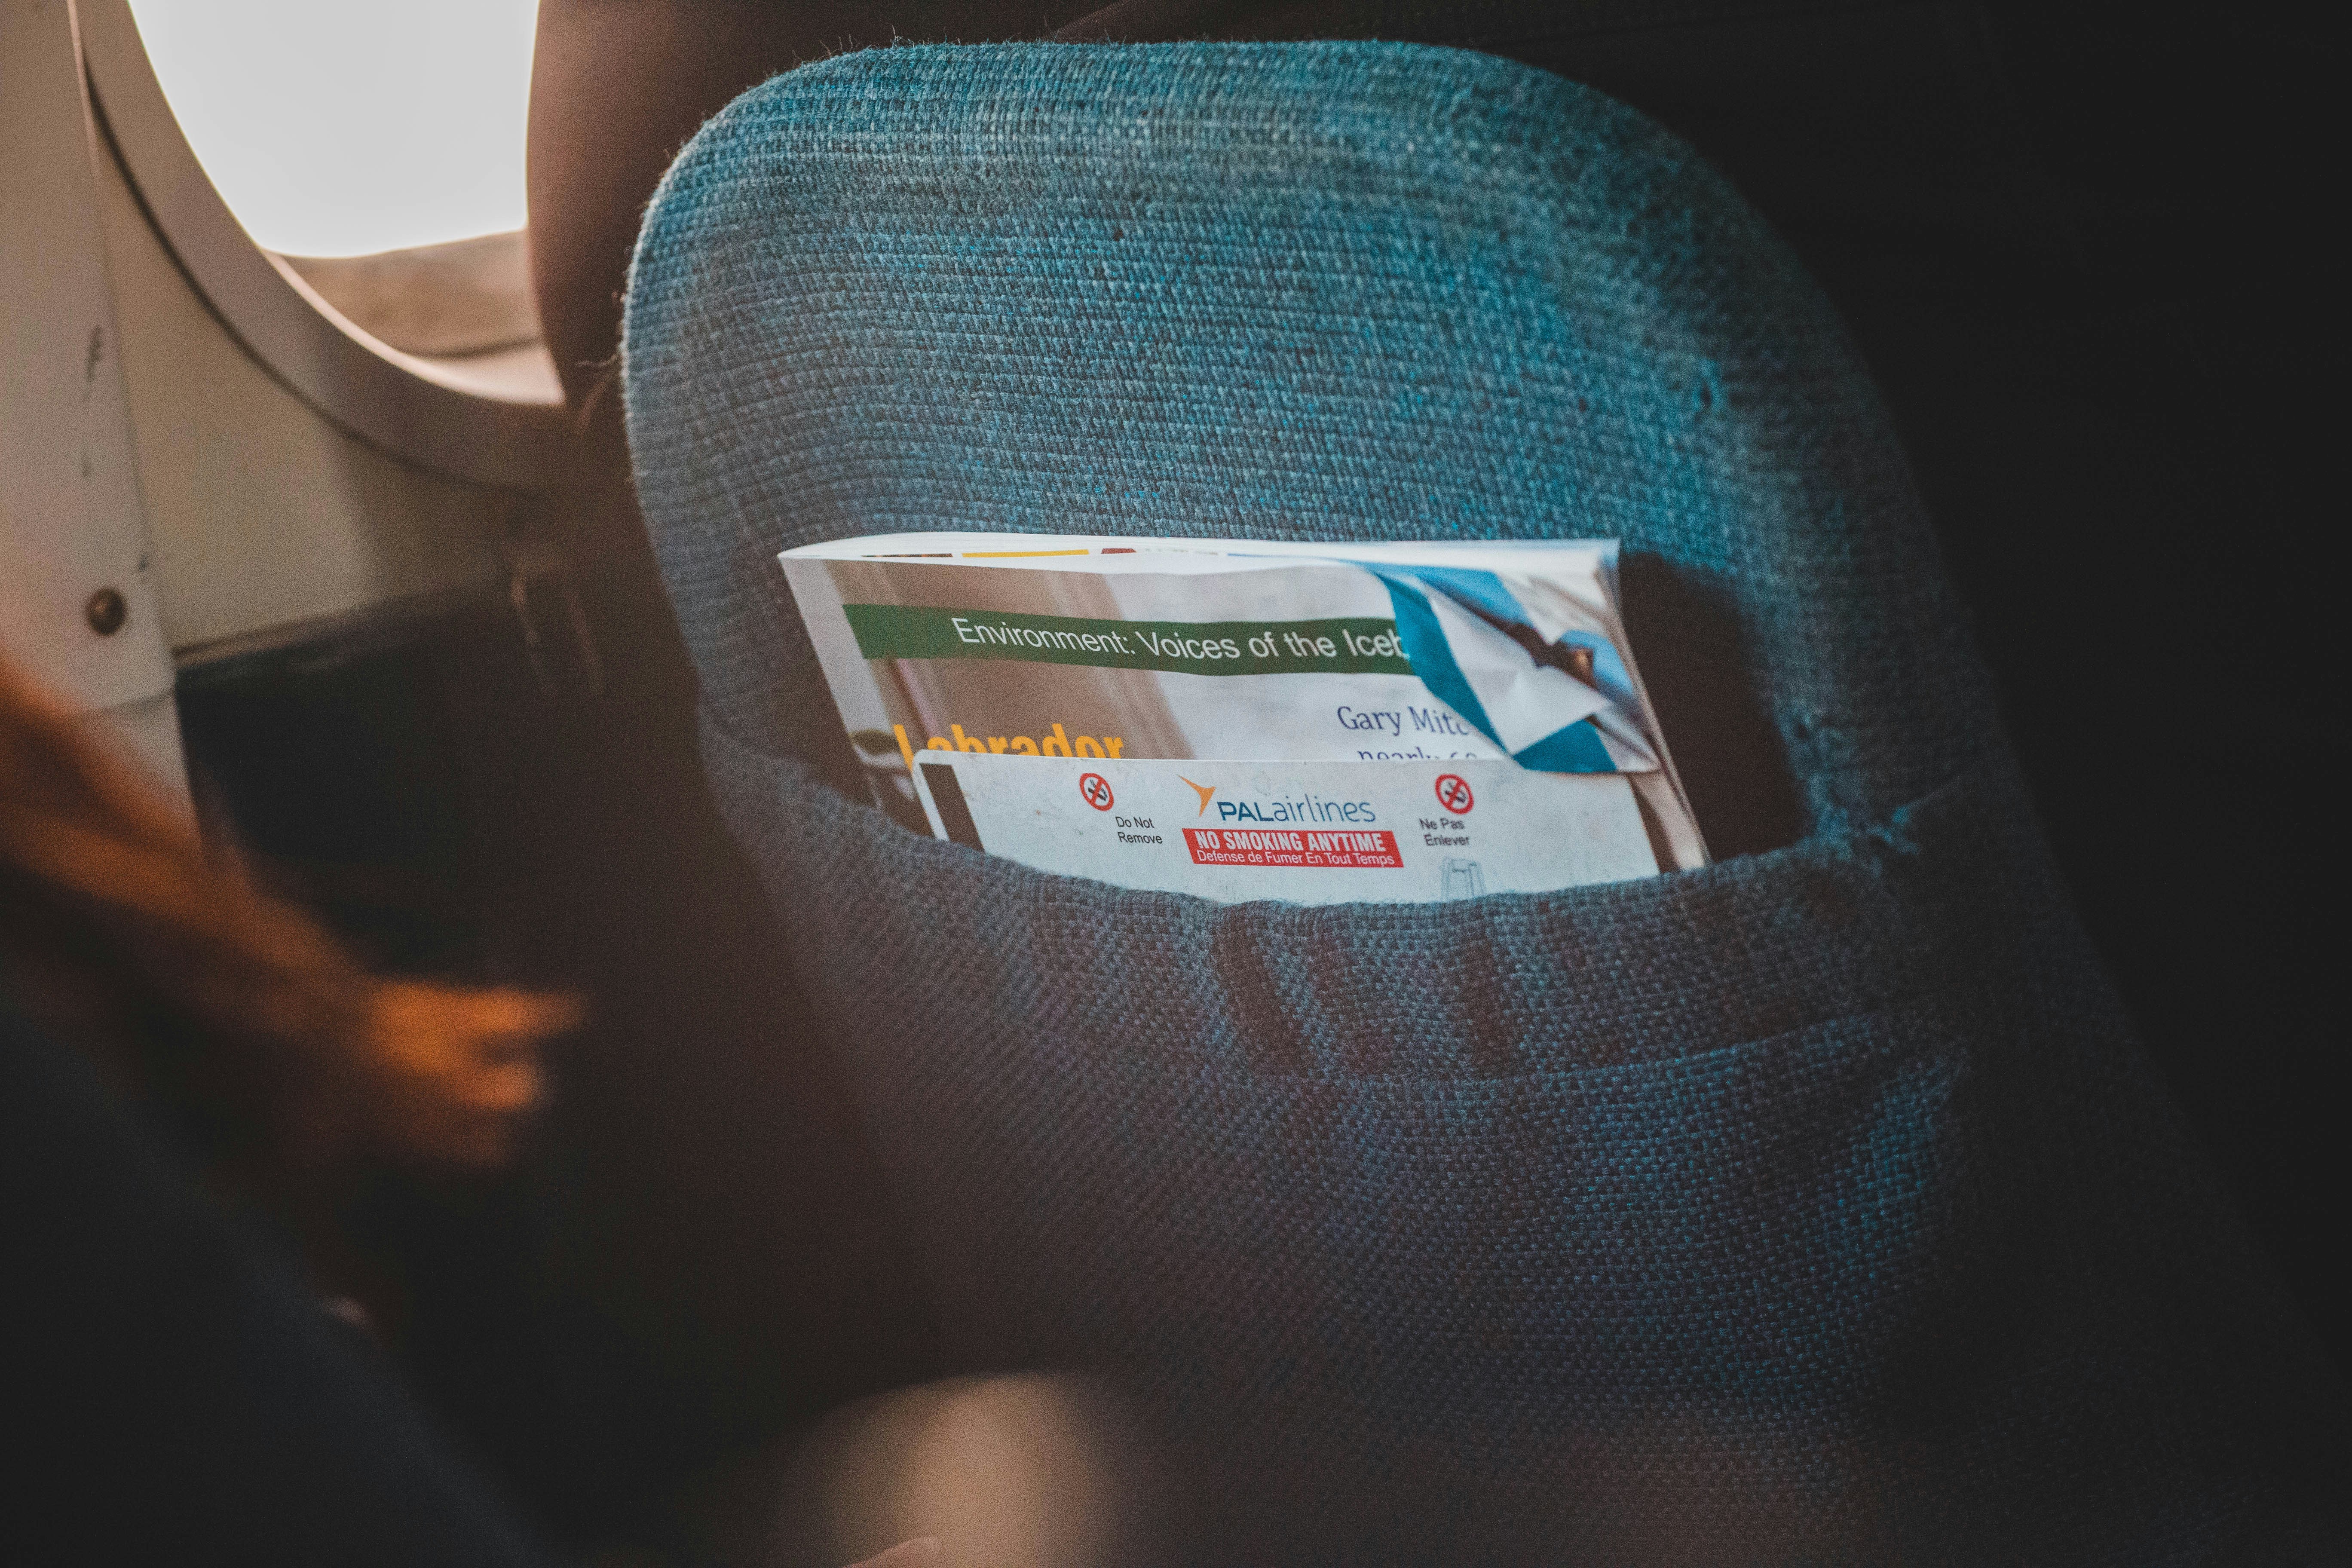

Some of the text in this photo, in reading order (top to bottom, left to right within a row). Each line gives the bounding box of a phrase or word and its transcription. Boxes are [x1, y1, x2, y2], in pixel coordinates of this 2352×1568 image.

[951, 617, 1136, 654] Environment:
[1135, 631, 1240, 659] Voices
[1249, 631, 1278, 658] of
[1284, 631, 1336, 658] the
[1337, 706, 1400, 736] Gary
[1115, 816, 1155, 828] Do Not
[1419, 818, 1465, 830] Ne Pas
[1118, 831, 1163, 844] Remove
[1194, 831, 1386, 852] NO SMOKING ANYTIME
[1424, 833, 1470, 846] Enlever
[1197, 850, 1395, 867] Defense de Fumer En Tout Temps
